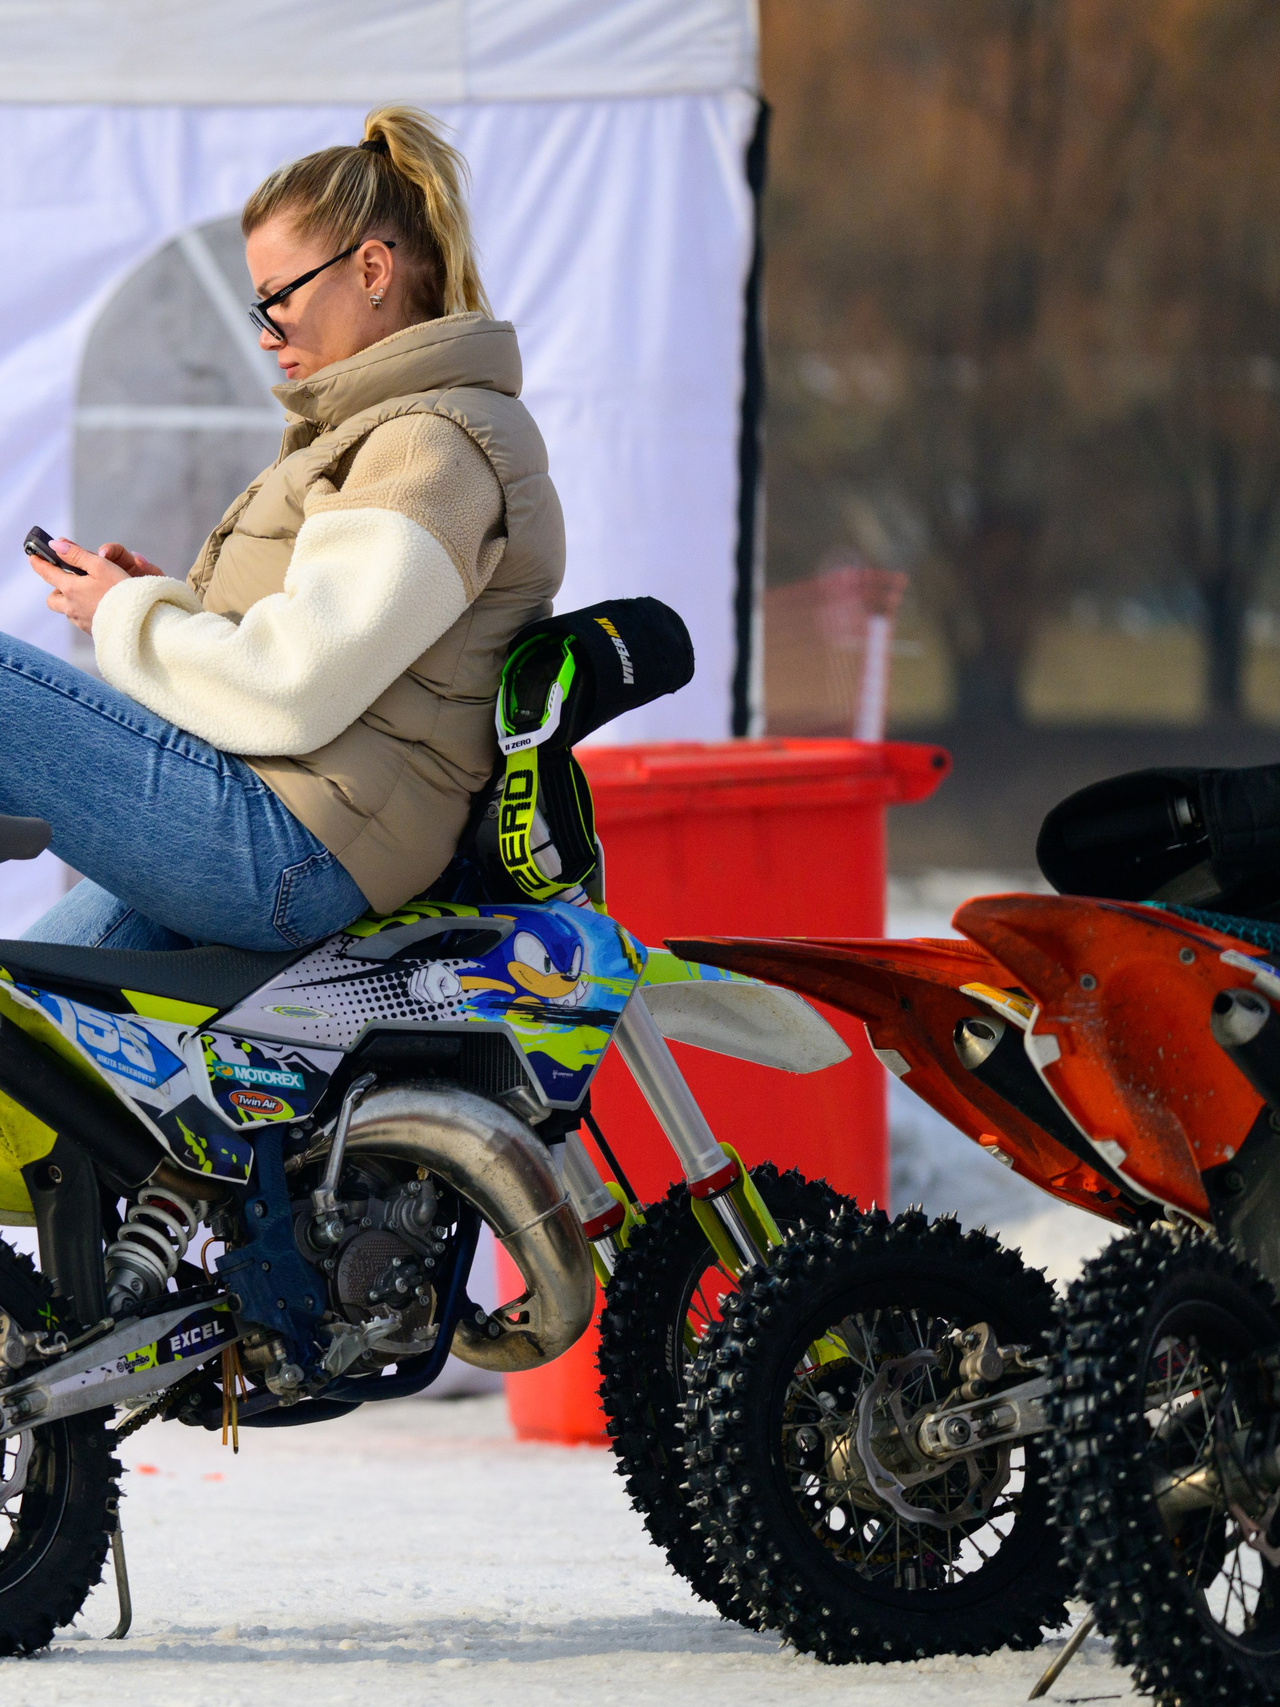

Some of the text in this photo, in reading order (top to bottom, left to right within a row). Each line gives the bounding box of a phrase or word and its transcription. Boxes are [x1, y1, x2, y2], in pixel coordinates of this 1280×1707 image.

[511, 738, 532, 749] ZERO
[501, 769, 551, 893] ZERO
[234, 1066, 301, 1088] MOTOREX
[238, 1095, 278, 1109] Twin Air
[169, 1320, 225, 1352] EXCEL
[125, 1354, 150, 1370] brembo
